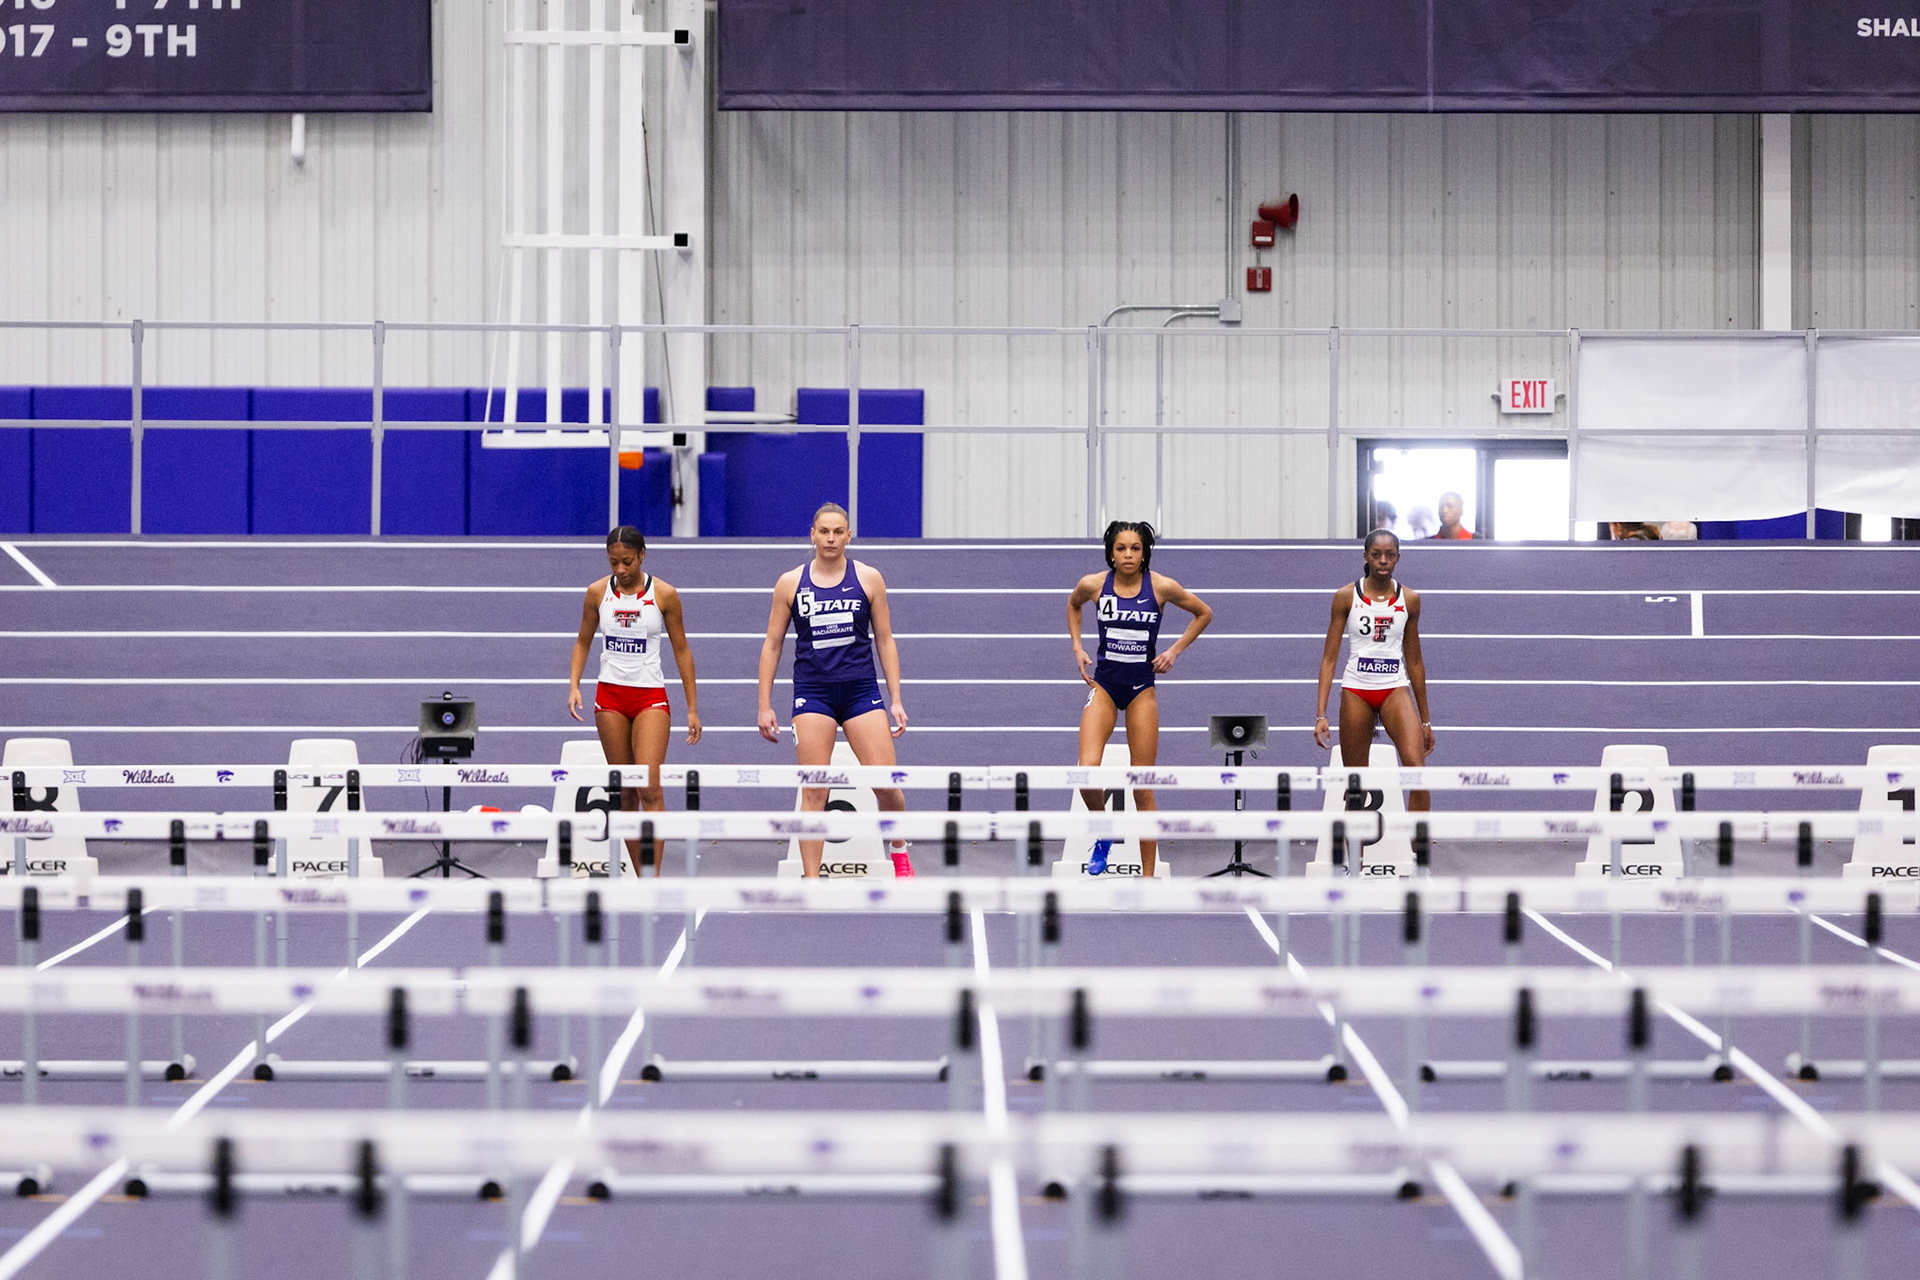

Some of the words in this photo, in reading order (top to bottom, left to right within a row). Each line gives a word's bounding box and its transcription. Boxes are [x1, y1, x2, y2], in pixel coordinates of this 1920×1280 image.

[1856, 17, 1920, 37] SHAL
[0, 24, 55, 57] 17
[106, 24, 197, 57] 9TH
[1511, 380, 1548, 408] EXIT
[801, 594, 811, 615] 5
[1102, 598, 1114, 619] 4
[1358, 615, 1371, 636] 3
[608, 640, 644, 653] SMITH
[1106, 642, 1147, 652] EDWARDS
[1358, 662, 1399, 673] HARRIS
[122, 769, 175, 784] Wildcats
[457, 769, 510, 783] Wildcats
[797, 770, 849, 784] Wildcats
[1126, 771, 1179, 785] Wildcats
[1458, 771, 1511, 786] Wildcats
[1792, 771, 1845, 785] Wildcats
[819, 863, 868, 874] ACER
[1871, 866, 1920, 878] PACE
